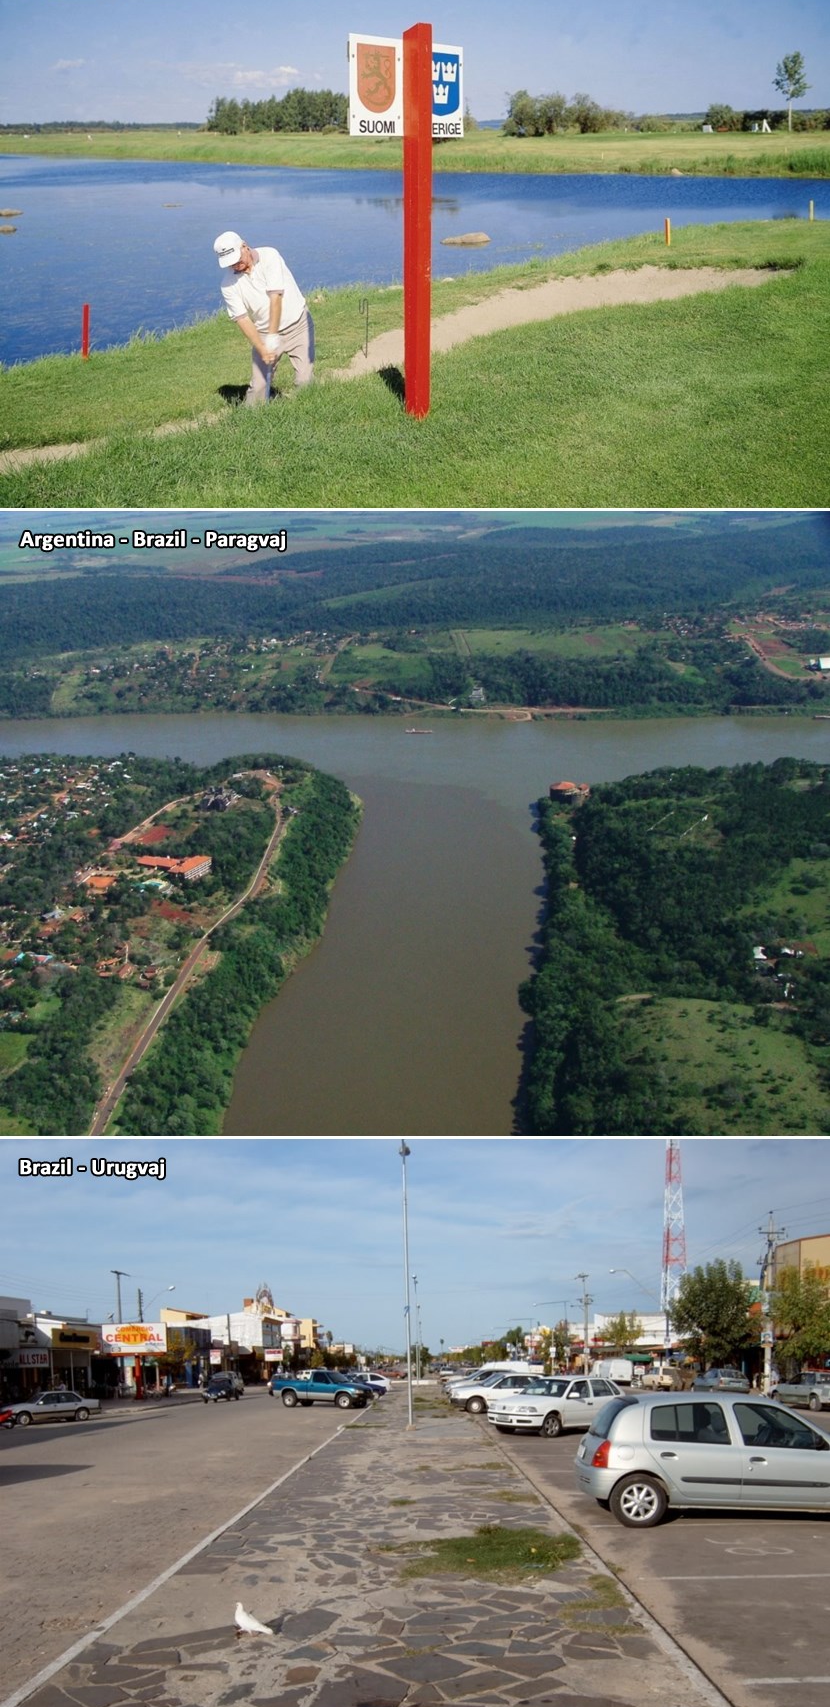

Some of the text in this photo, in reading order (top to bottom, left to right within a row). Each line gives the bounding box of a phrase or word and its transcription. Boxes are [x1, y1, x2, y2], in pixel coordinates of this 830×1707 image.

[359, 120, 396, 134] SUOMI
[432, 122, 462, 135] ERIGE
[115, 1325, 154, 1333] COMERCIO
[105, 1332, 164, 1343] CENTRAL
[18, 1353, 31, 1367] ALL
[31, 1353, 49, 1365] STAR
